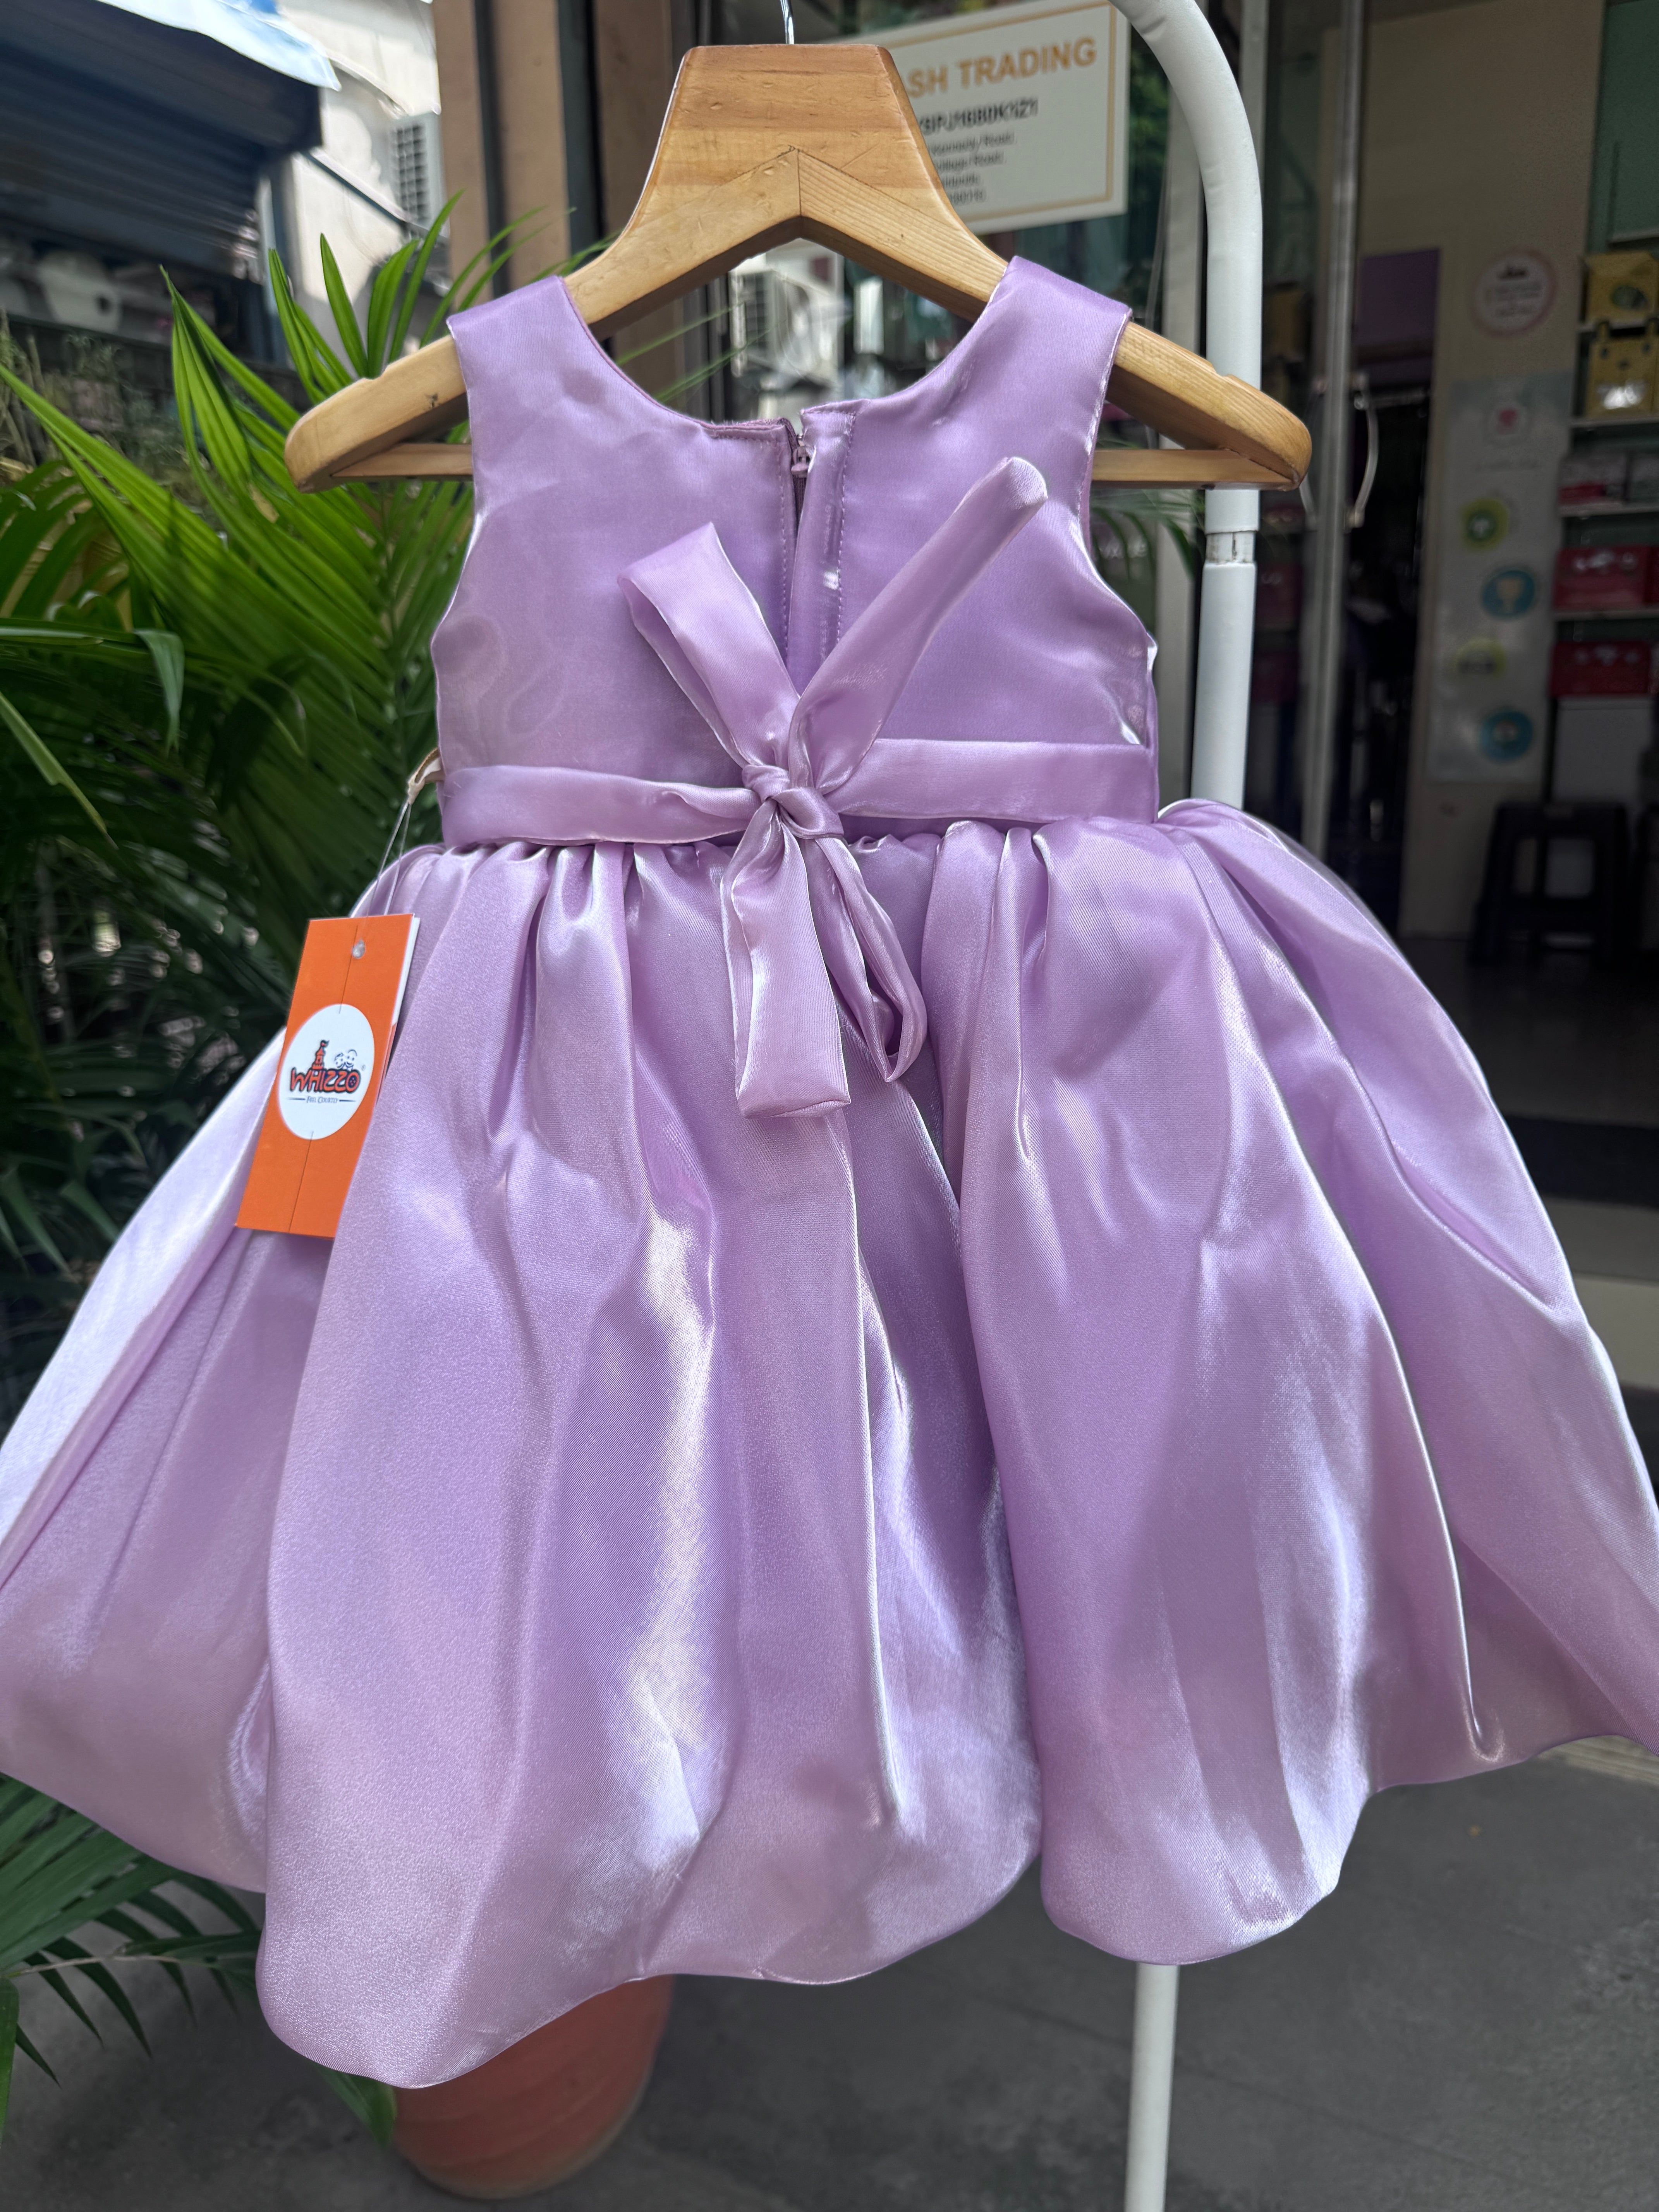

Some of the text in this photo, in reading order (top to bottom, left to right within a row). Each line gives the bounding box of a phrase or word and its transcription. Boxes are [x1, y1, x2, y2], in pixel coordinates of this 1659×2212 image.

[907, 37, 1096, 98] SH TRADING
[290, 1068, 361, 1094] WHIZZO
